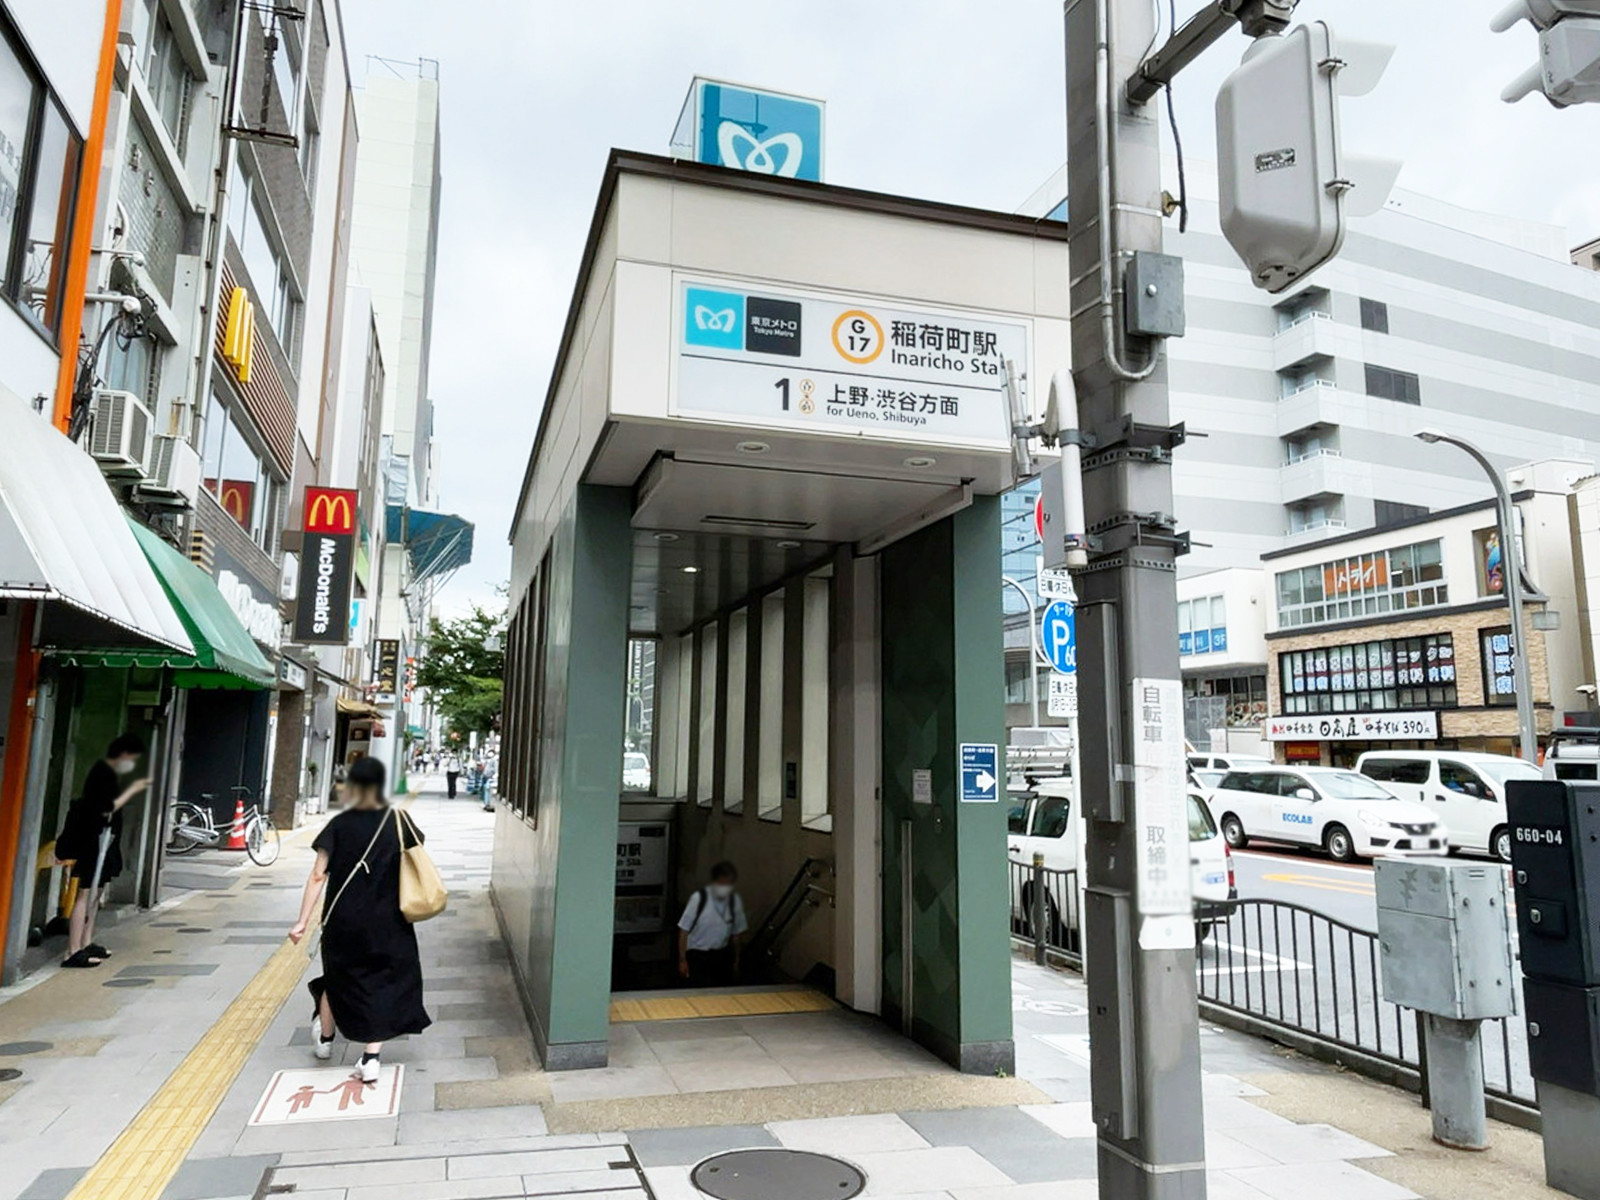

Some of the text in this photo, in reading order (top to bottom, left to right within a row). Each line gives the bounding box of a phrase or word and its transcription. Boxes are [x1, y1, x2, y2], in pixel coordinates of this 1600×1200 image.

[750, 315, 798, 331] 東京メトロ
[754, 326, 795, 338] Tokyo Metro
[851, 319, 866, 334] G
[847, 335, 871, 352] 17
[890, 320, 998, 357] 稲荷町駅
[891, 348, 965, 372] Inaricho
[774, 377, 790, 411] 1
[826, 405, 927, 426] for Ueno, Shibuya
[312, 537, 336, 635] McDonald's
[1337, 564, 1376, 588] トライ
[1142, 686, 1163, 743] 自転車
[1282, 812, 1313, 824] ECOLAB
[1516, 827, 1562, 845] 660-04
[1147, 824, 1168, 887] 取締中
